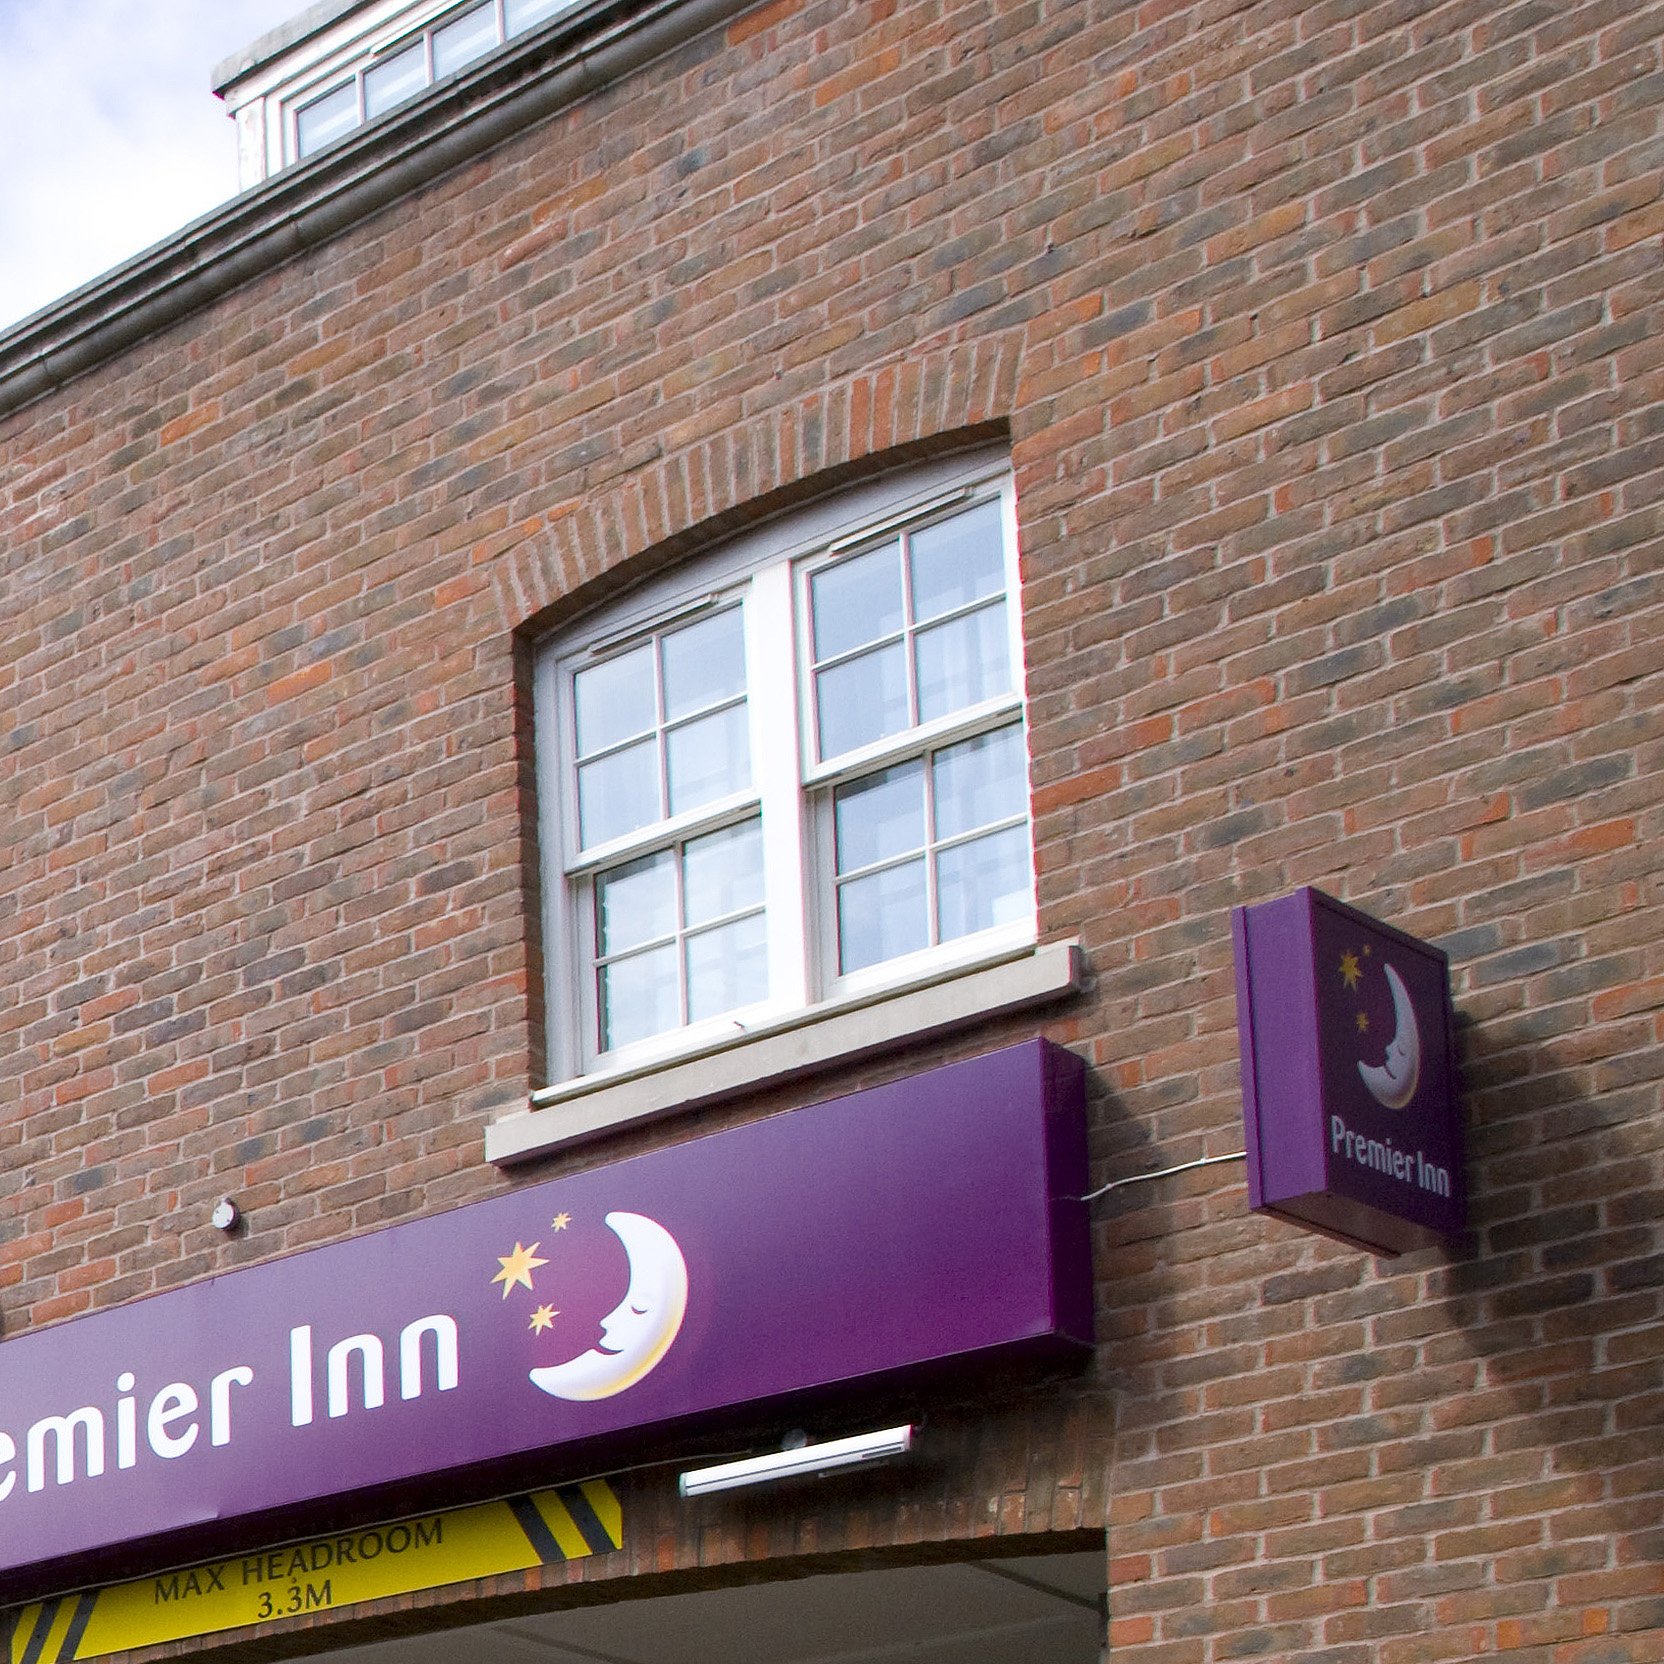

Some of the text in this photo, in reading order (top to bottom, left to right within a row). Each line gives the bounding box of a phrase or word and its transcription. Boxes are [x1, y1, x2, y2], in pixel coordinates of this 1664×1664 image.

[1330, 1114, 1450, 1198] Premier Inn
[289, 1313, 459, 1427] Inn
[153, 1517, 444, 1605] MAX HEADROOM
[257, 1579, 333, 1620] 3.3M
